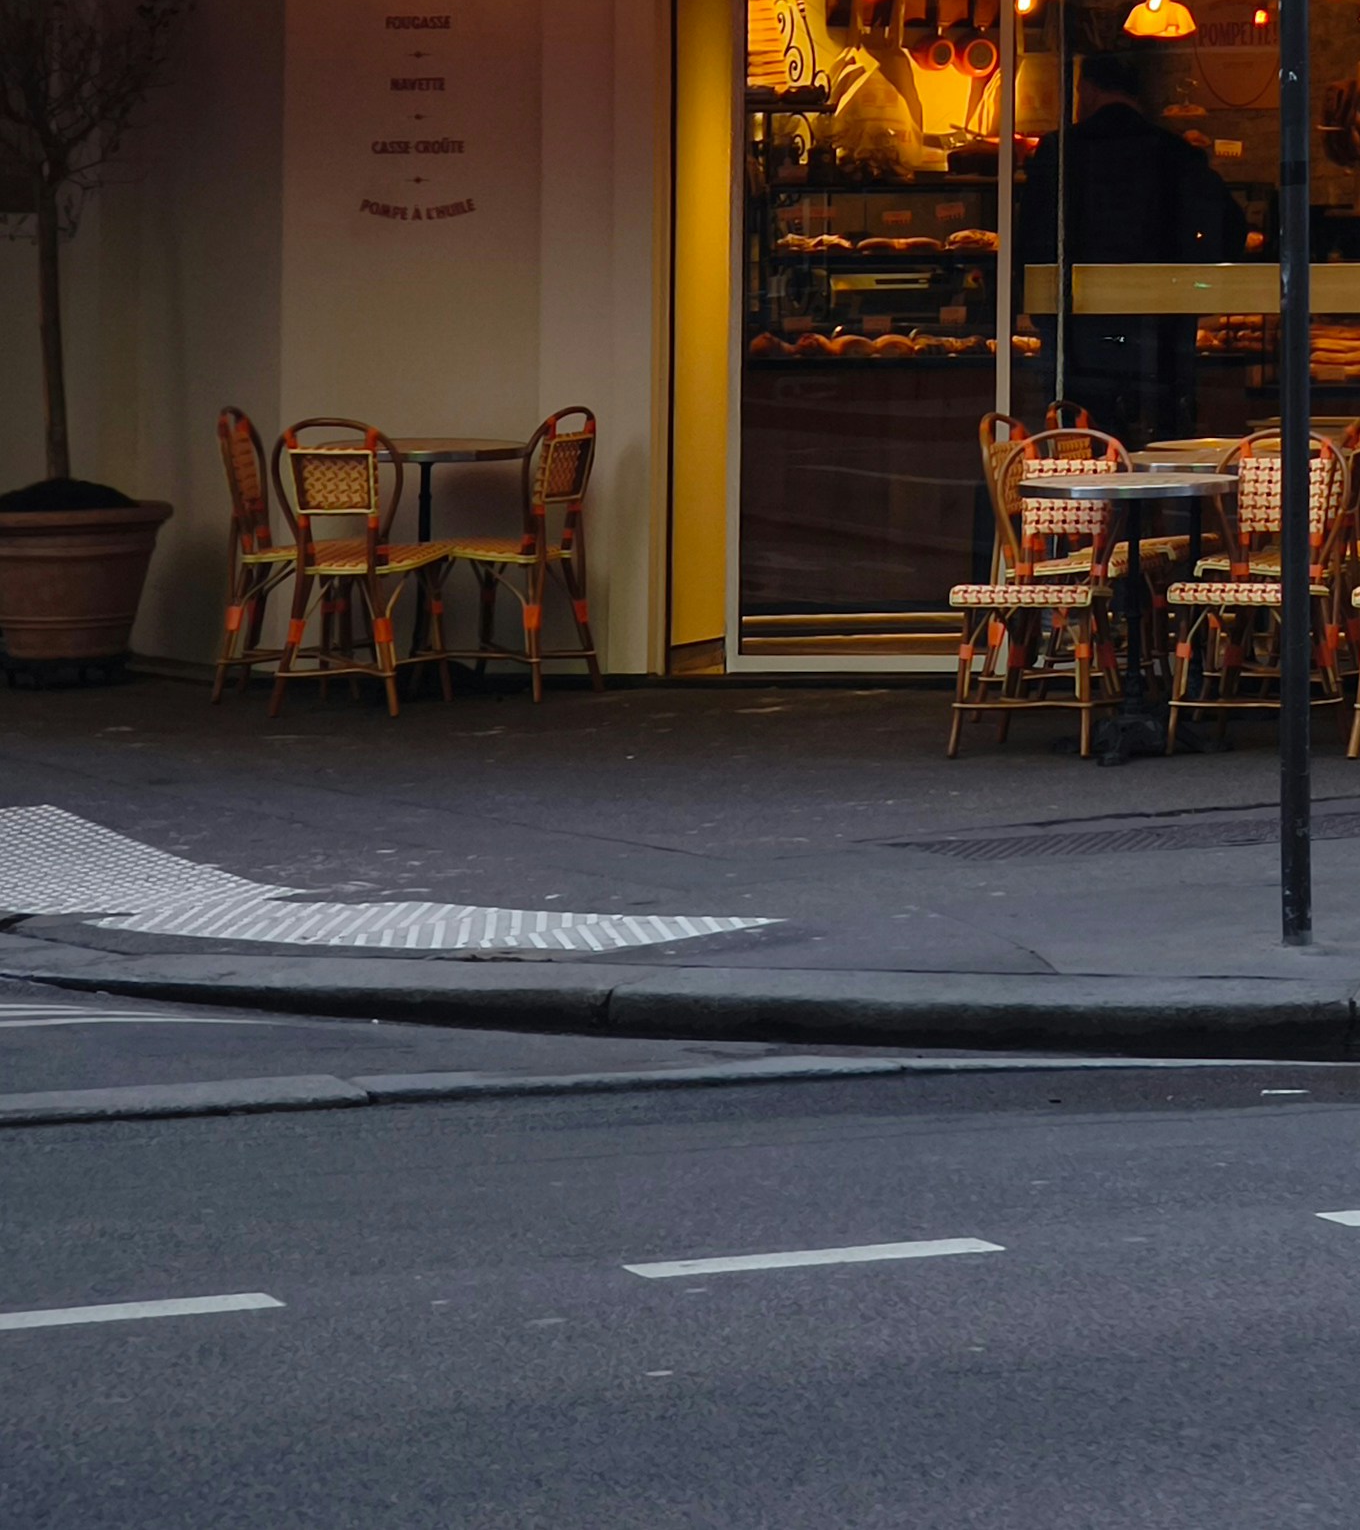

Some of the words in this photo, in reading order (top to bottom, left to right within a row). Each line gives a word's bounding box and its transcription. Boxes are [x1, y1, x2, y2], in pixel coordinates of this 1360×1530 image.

[385, 15, 452, 30] FOUGASSE
[389, 77, 446, 91] NAVETTE
[359, 198, 408, 221] POMPE
[411, 205, 423, 221] À
